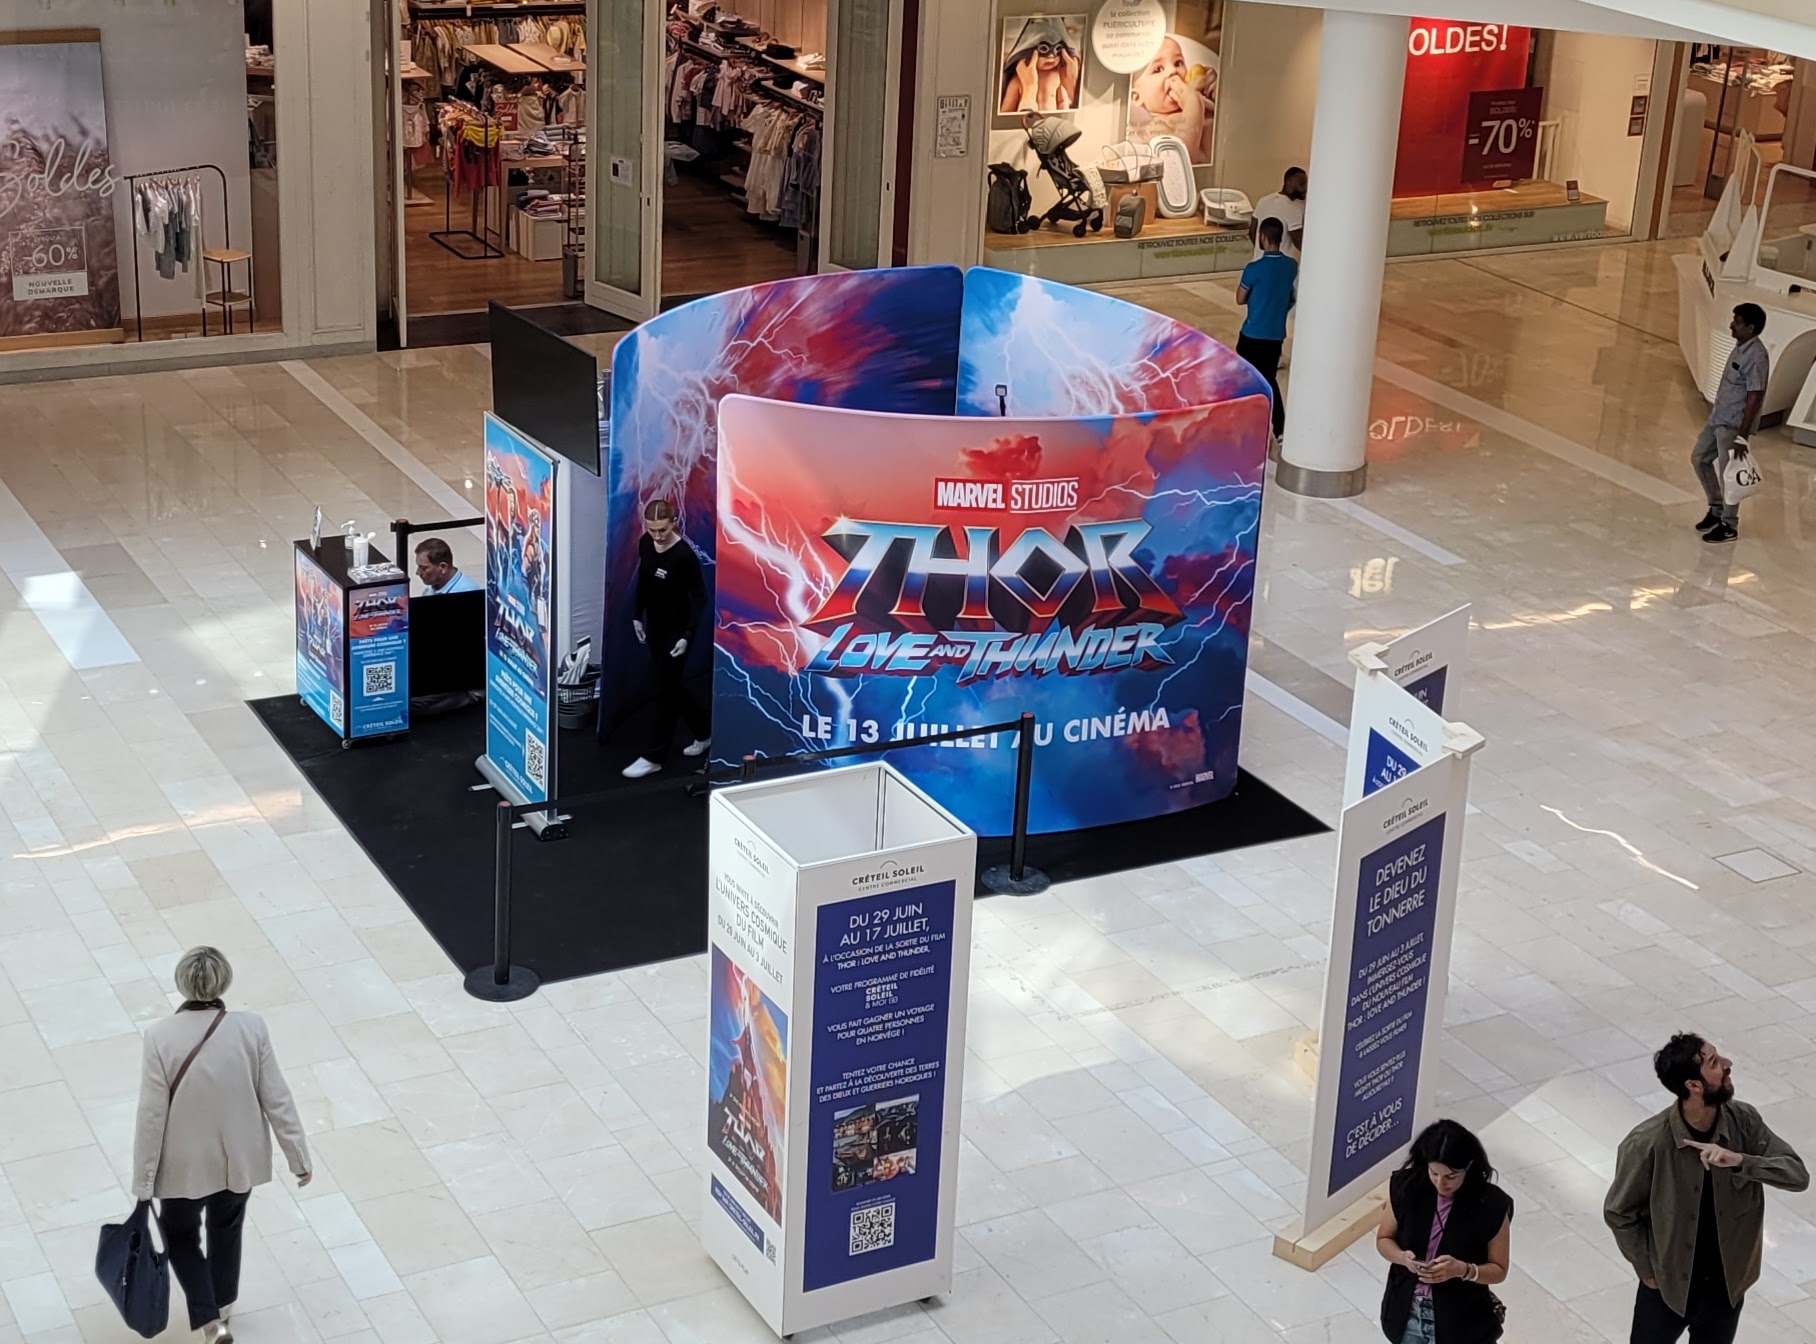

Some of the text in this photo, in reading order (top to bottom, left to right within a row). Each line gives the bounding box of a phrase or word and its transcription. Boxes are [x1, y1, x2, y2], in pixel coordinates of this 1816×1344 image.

[1408, 24, 1508, 56] OLDES!
[23, 244, 78, 268] -60%
[28, 278, 74, 289] NOUVELLE
[1736, 467, 1762, 486] C&A
[937, 481, 1079, 512] MARVEL STUDIOS
[800, 516, 1188, 628] THOR
[804, 621, 1177, 684] LOVE AND THUNDER
[802, 713, 832, 740] LE
[848, 718, 880, 744] 13
[1063, 707, 1171, 743] CINÉMA
[1383, 811, 1407, 829] CRÉTEIL
[1408, 798, 1429, 815] SOLEIL
[852, 864, 925, 886] CRÉTEIL SOLEIL
[1375, 843, 1427, 887] DEVENEZ
[1369, 865, 1428, 914] LE DIEU DU
[715, 876, 788, 955] L'UNIVERS COSMIQUE
[850, 902, 923, 929] DU 29 JUIN
[1366, 888, 1426, 938] TONNERRE
[736, 913, 764, 950] DU FILM
[840, 917, 930, 948] AU 17 JUILLET,
[830, 945, 874, 962] L'OCCASION
[874, 944, 884, 953] DE
[885, 942, 894, 951] LA
[895, 936, 918, 949] SORTIE
[919, 934, 930, 944] DU
[930, 932, 946, 942] FILM
[837, 960, 857, 971] THOR
[861, 954, 880, 966] LOVE
[880, 950, 897, 961] AND
[760, 957, 783, 986] JUILLET
[830, 982, 853, 994] VOTRE
[854, 973, 899, 990] PROGRAMME
[909, 964, 936, 978] FIDÉLITÉ
[865, 982, 899, 995] CRÉTEIL
[865, 990, 894, 1002] SOLEIL
[827, 1003, 935, 1033] VOUS FAIT GAGNER UN VOYAGE
[836, 1015, 925, 1040] POUR QUATRE PERSONNES
[856, 1037, 867, 1046] EN
[816, 1087, 825, 1095] ET
[825, 1081, 847, 1093] PARTEZ
[854, 1077, 863, 1086] LA
[863, 1068, 905, 1084] DÉCOUVERTE
[905, 1065, 918, 1075] DES
[918, 1060, 940, 1071] TERRES
[842, 1057, 916, 1080] TENTEZ VOTRE CHANCE
[819, 1094, 832, 1103] DES
[852, 1087, 860, 1096] ET
[860, 1080, 894, 1094] GUERRIERS
[894, 1071, 933, 1086] NORDIQUES
[1346, 1096, 1403, 1145] C'EST À VOUS
[1345, 1140, 1357, 1159] DE
